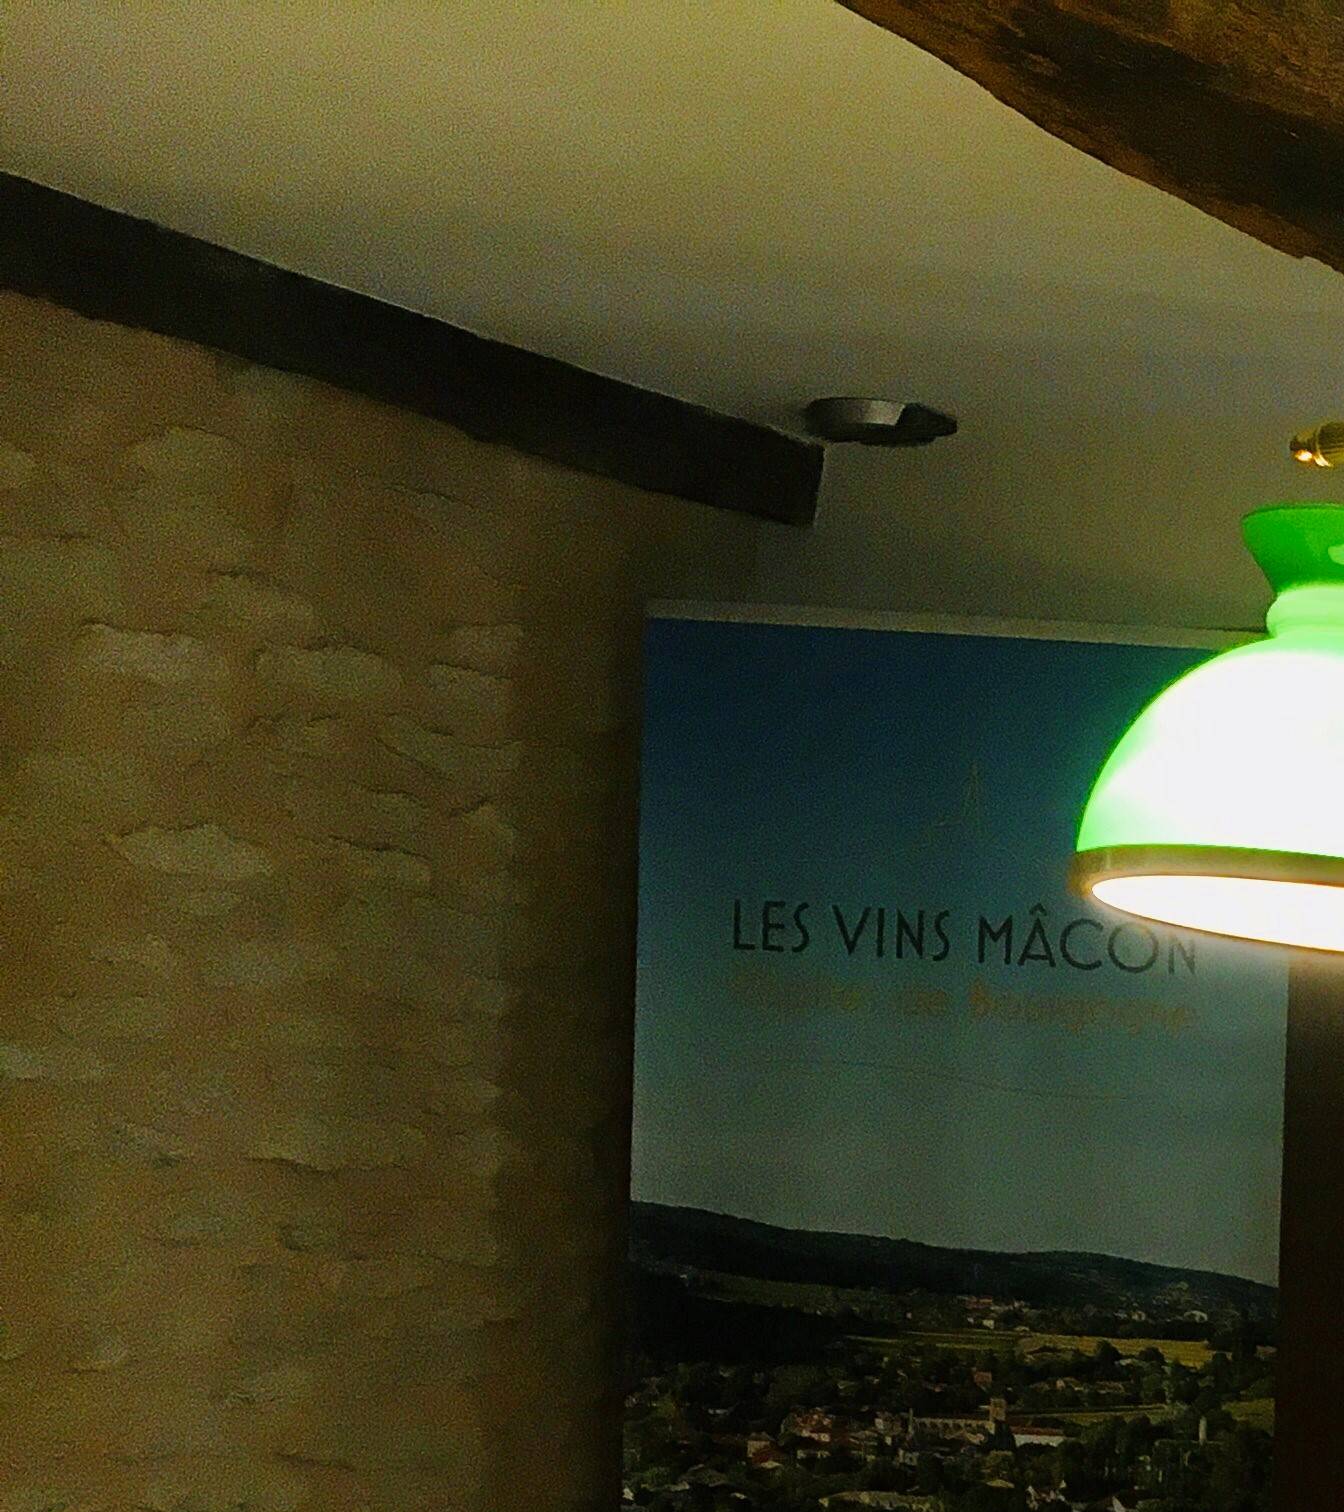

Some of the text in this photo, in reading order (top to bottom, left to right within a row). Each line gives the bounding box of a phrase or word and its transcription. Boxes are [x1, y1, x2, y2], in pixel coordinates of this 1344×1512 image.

[732, 899, 1197, 975] LES VINS MÂCON
